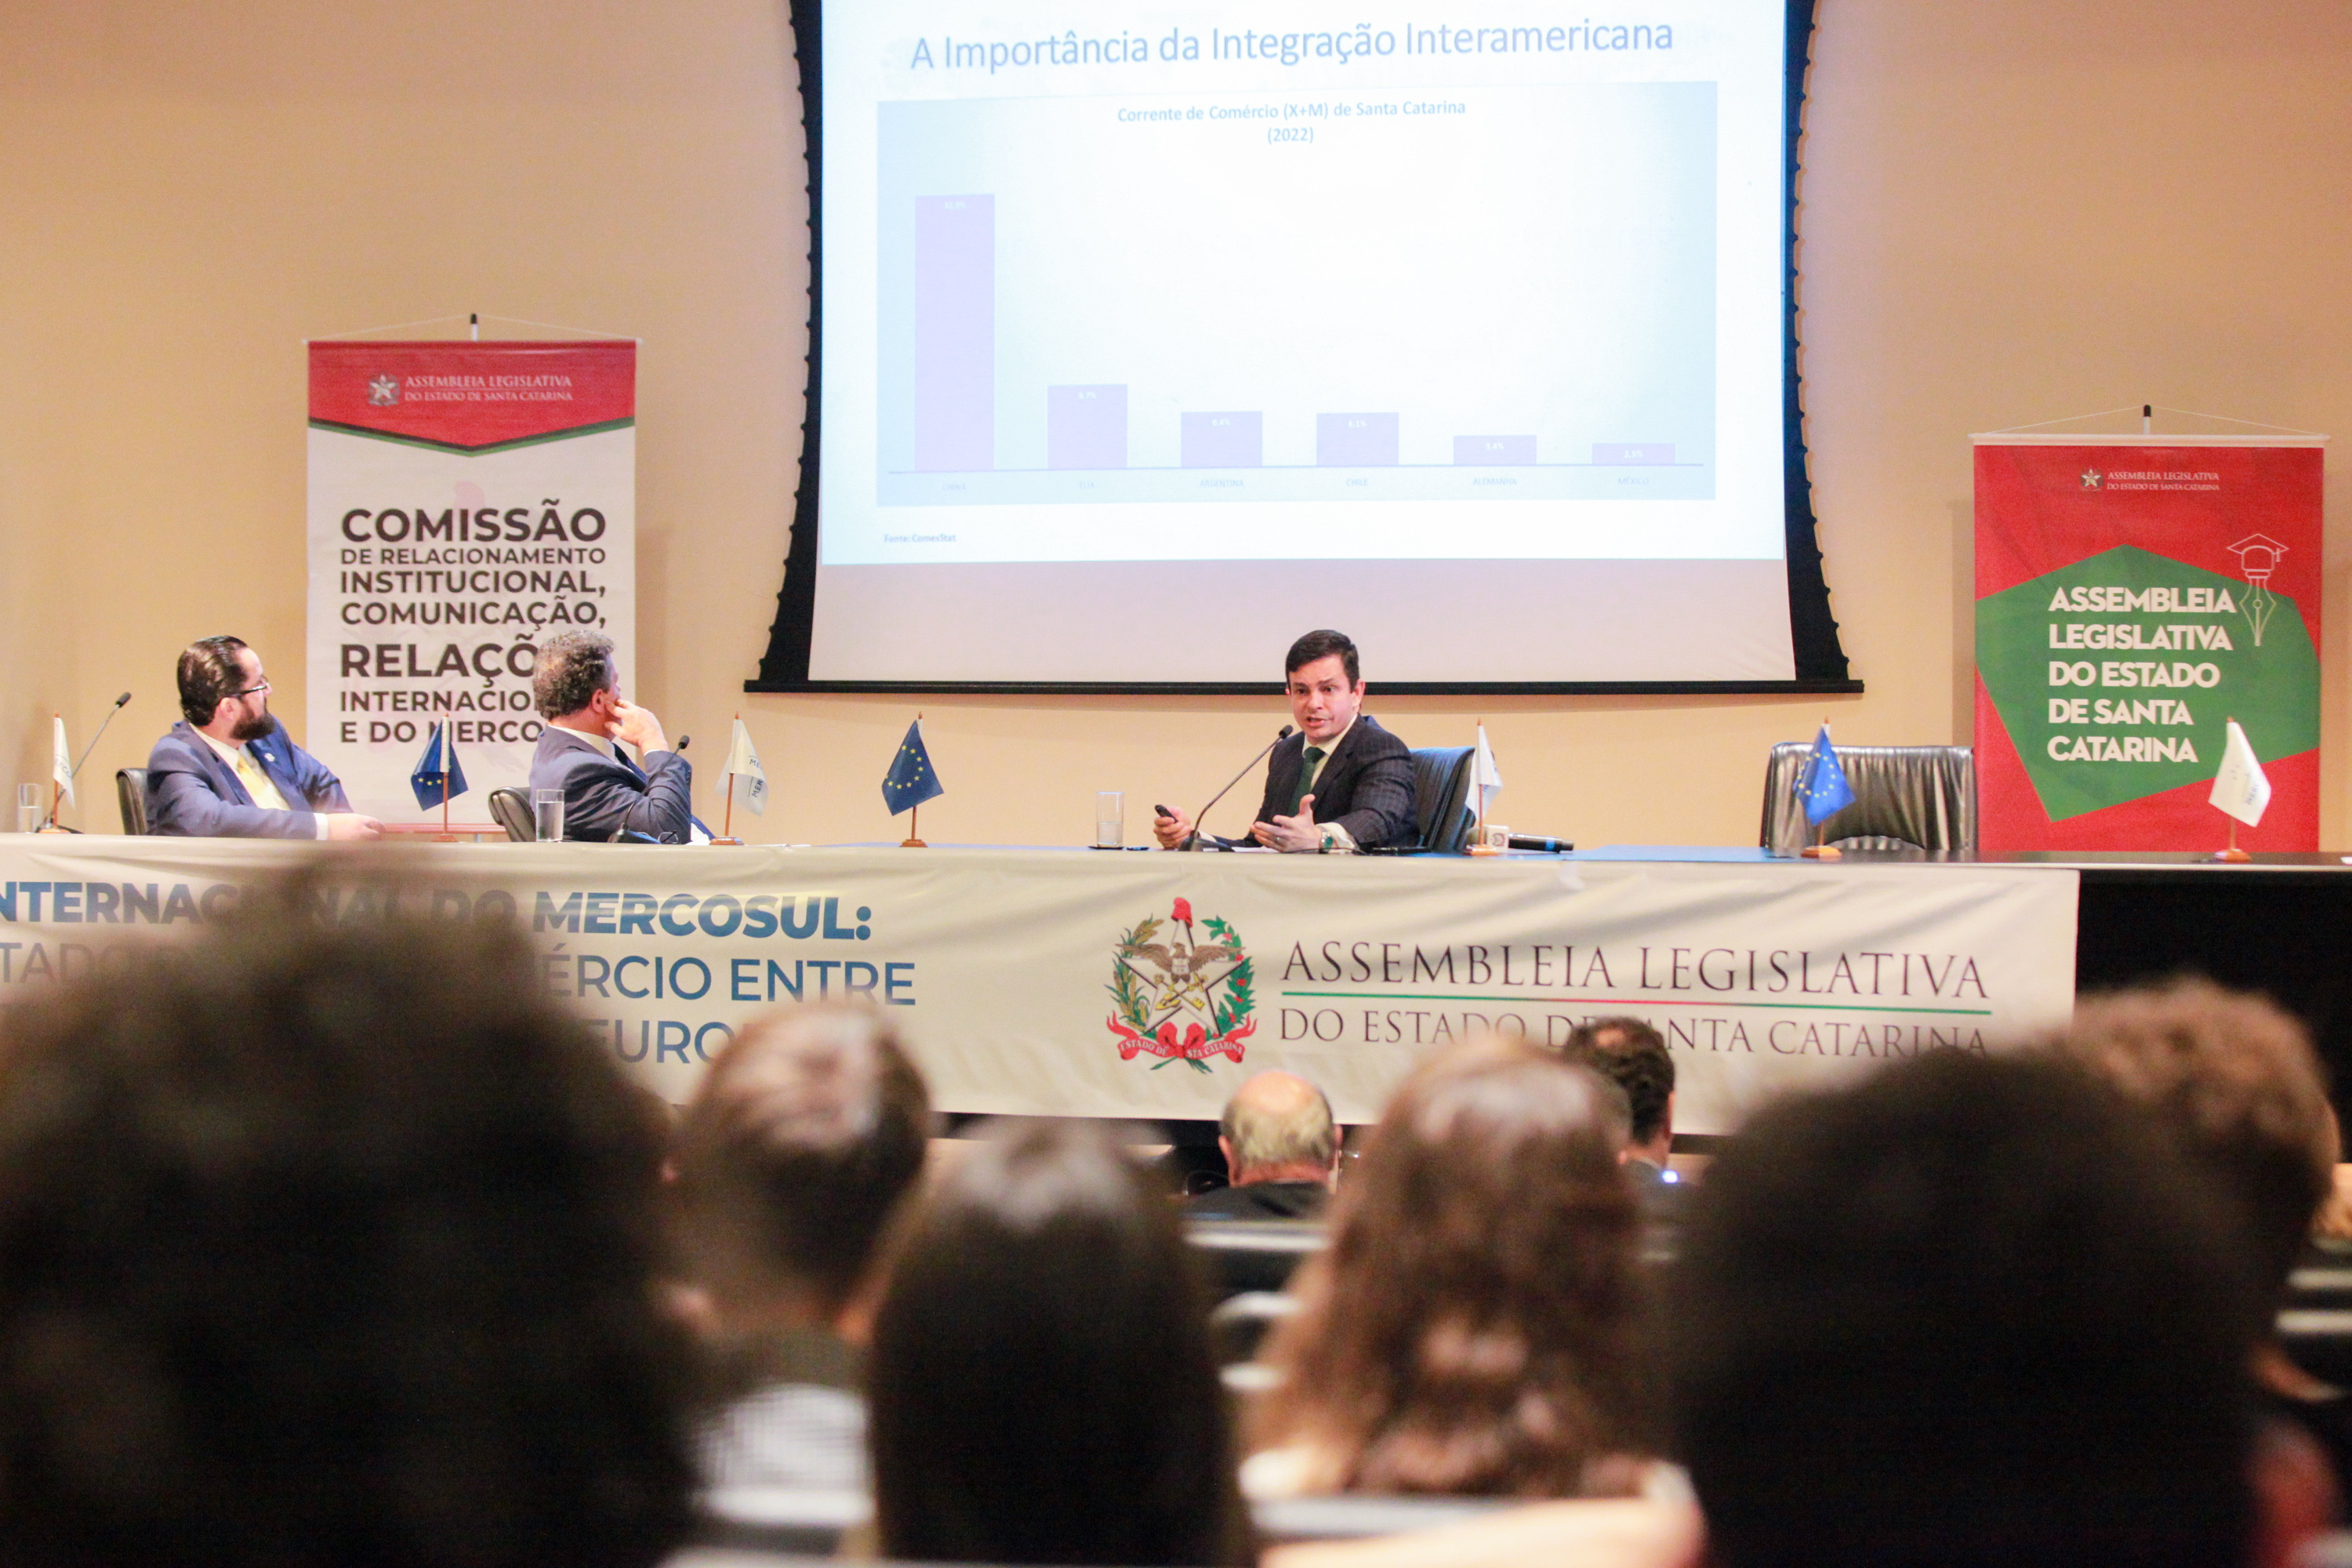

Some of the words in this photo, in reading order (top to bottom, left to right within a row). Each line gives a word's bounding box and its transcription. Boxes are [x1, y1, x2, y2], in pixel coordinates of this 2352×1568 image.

[911, 38, 934, 69] A
[946, 30, 1149, 74] Importância
[1159, 27, 1200, 61] da
[1213, 22, 1396, 66] Integração
[1406, 18, 1673, 54] Interamericana
[1118, 107, 1182, 122] Corrente
[1186, 106, 1204, 121] de
[1209, 103, 1279, 119] Comércio
[1283, 101, 1329, 120] (X+M)
[1334, 102, 1352, 117] de
[1356, 102, 1398, 116] Santa
[1403, 100, 1466, 115] Catarina
[1268, 126, 1314, 144] (2022)
[405, 375, 486, 387] ASSEMBLEIA
[488, 375, 572, 387] LEGISLATIVA
[405, 392, 422, 401] DO
[424, 392, 466, 401] ESTADO
[467, 392, 481, 401] DE
[484, 392, 517, 401] SANTA
[519, 392, 573, 401] CATARINA
[1200, 479, 1244, 488] ARGENTINA
[1345, 478, 1368, 487] CHILE
[1473, 477, 1517, 486] ALEMANHA
[2107, 471, 2161, 481] ASSEMBLEIA
[2163, 472, 2220, 481] LEGISLATIVA
[2183, 483, 2220, 492] CATARINA
[341, 499, 606, 543] COMISSÃO
[884, 534, 910, 543] Fonte:
[912, 533, 956, 543] ComexStat
[340, 548, 372, 564] DE
[380, 548, 606, 564] RELACIONAMENTO
[340, 570, 606, 597] INSTITUCIONAL,
[2048, 586, 2237, 613] ASSEMBLEIA
[341, 594, 606, 631] COMUNICAÇÃO,
[2049, 624, 2234, 651] LEGISLATIVA
[340, 633, 539, 688] RELAÇÕ
[2049, 661, 2096, 687] DO
[2101, 662, 2220, 688] ESTADO
[340, 690, 536, 712] INTERNACIO
[2048, 699, 2089, 724] DE
[2092, 699, 2194, 725] SANTA
[340, 721, 358, 742] E
[370, 720, 416, 743] DO
[2047, 736, 2199, 763] CATARINA
[533, 891, 872, 941] MERCOSUL:
[543, 943, 712, 1000] ÉRCIO
[731, 959, 916, 1006] ENTRE
[1280, 941, 1617, 988] ASSEMBLEIA
[1639, 946, 1990, 999] LEGISLATIVA
[1280, 1008, 1344, 1043] DO
[1363, 1010, 1526, 1045] ESTADO
[1768, 1018, 1988, 1058] CATARINA
[1120, 1040, 1155, 1051] ESTADO
[1156, 1046, 1168, 1056] DE
[1187, 1047, 1203, 1058] STA
[1204, 1041, 1243, 1055] CATARINA
